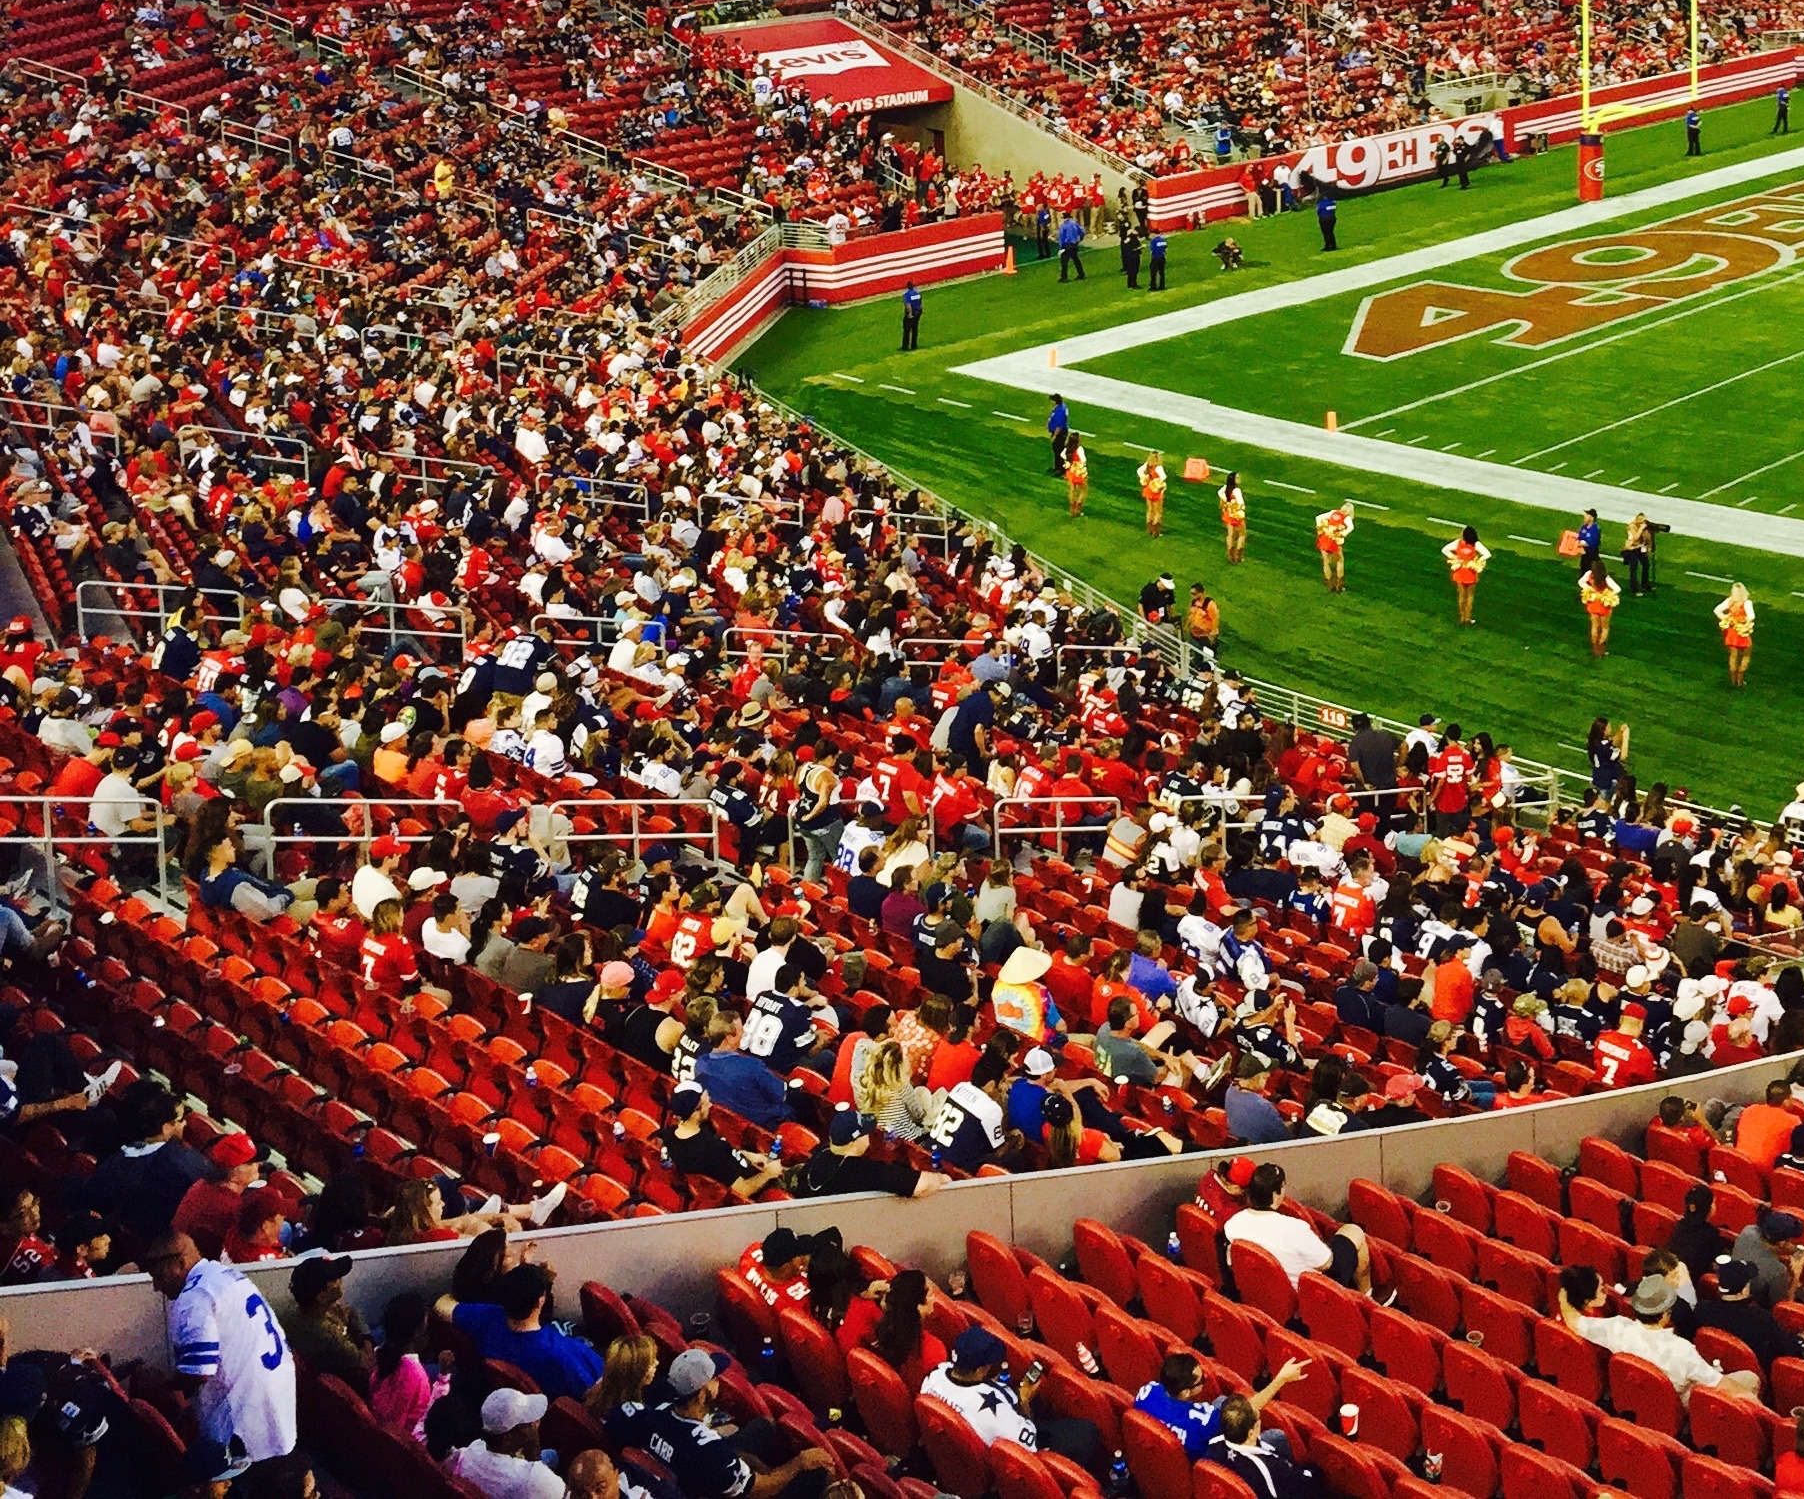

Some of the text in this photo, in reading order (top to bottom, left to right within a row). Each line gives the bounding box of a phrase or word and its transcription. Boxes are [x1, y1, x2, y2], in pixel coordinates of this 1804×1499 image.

[770, 49, 868, 73] evi's
[875, 89, 929, 109] STADIUM
[1291, 115, 1493, 190] 49ERS
[1321, 708, 1346, 727] 119
[1415, 932, 1437, 960] 9
[1602, 1056, 1618, 1085] 7
[245, 1292, 284, 1372] 3
[649, 1432, 676, 1463] CARR
